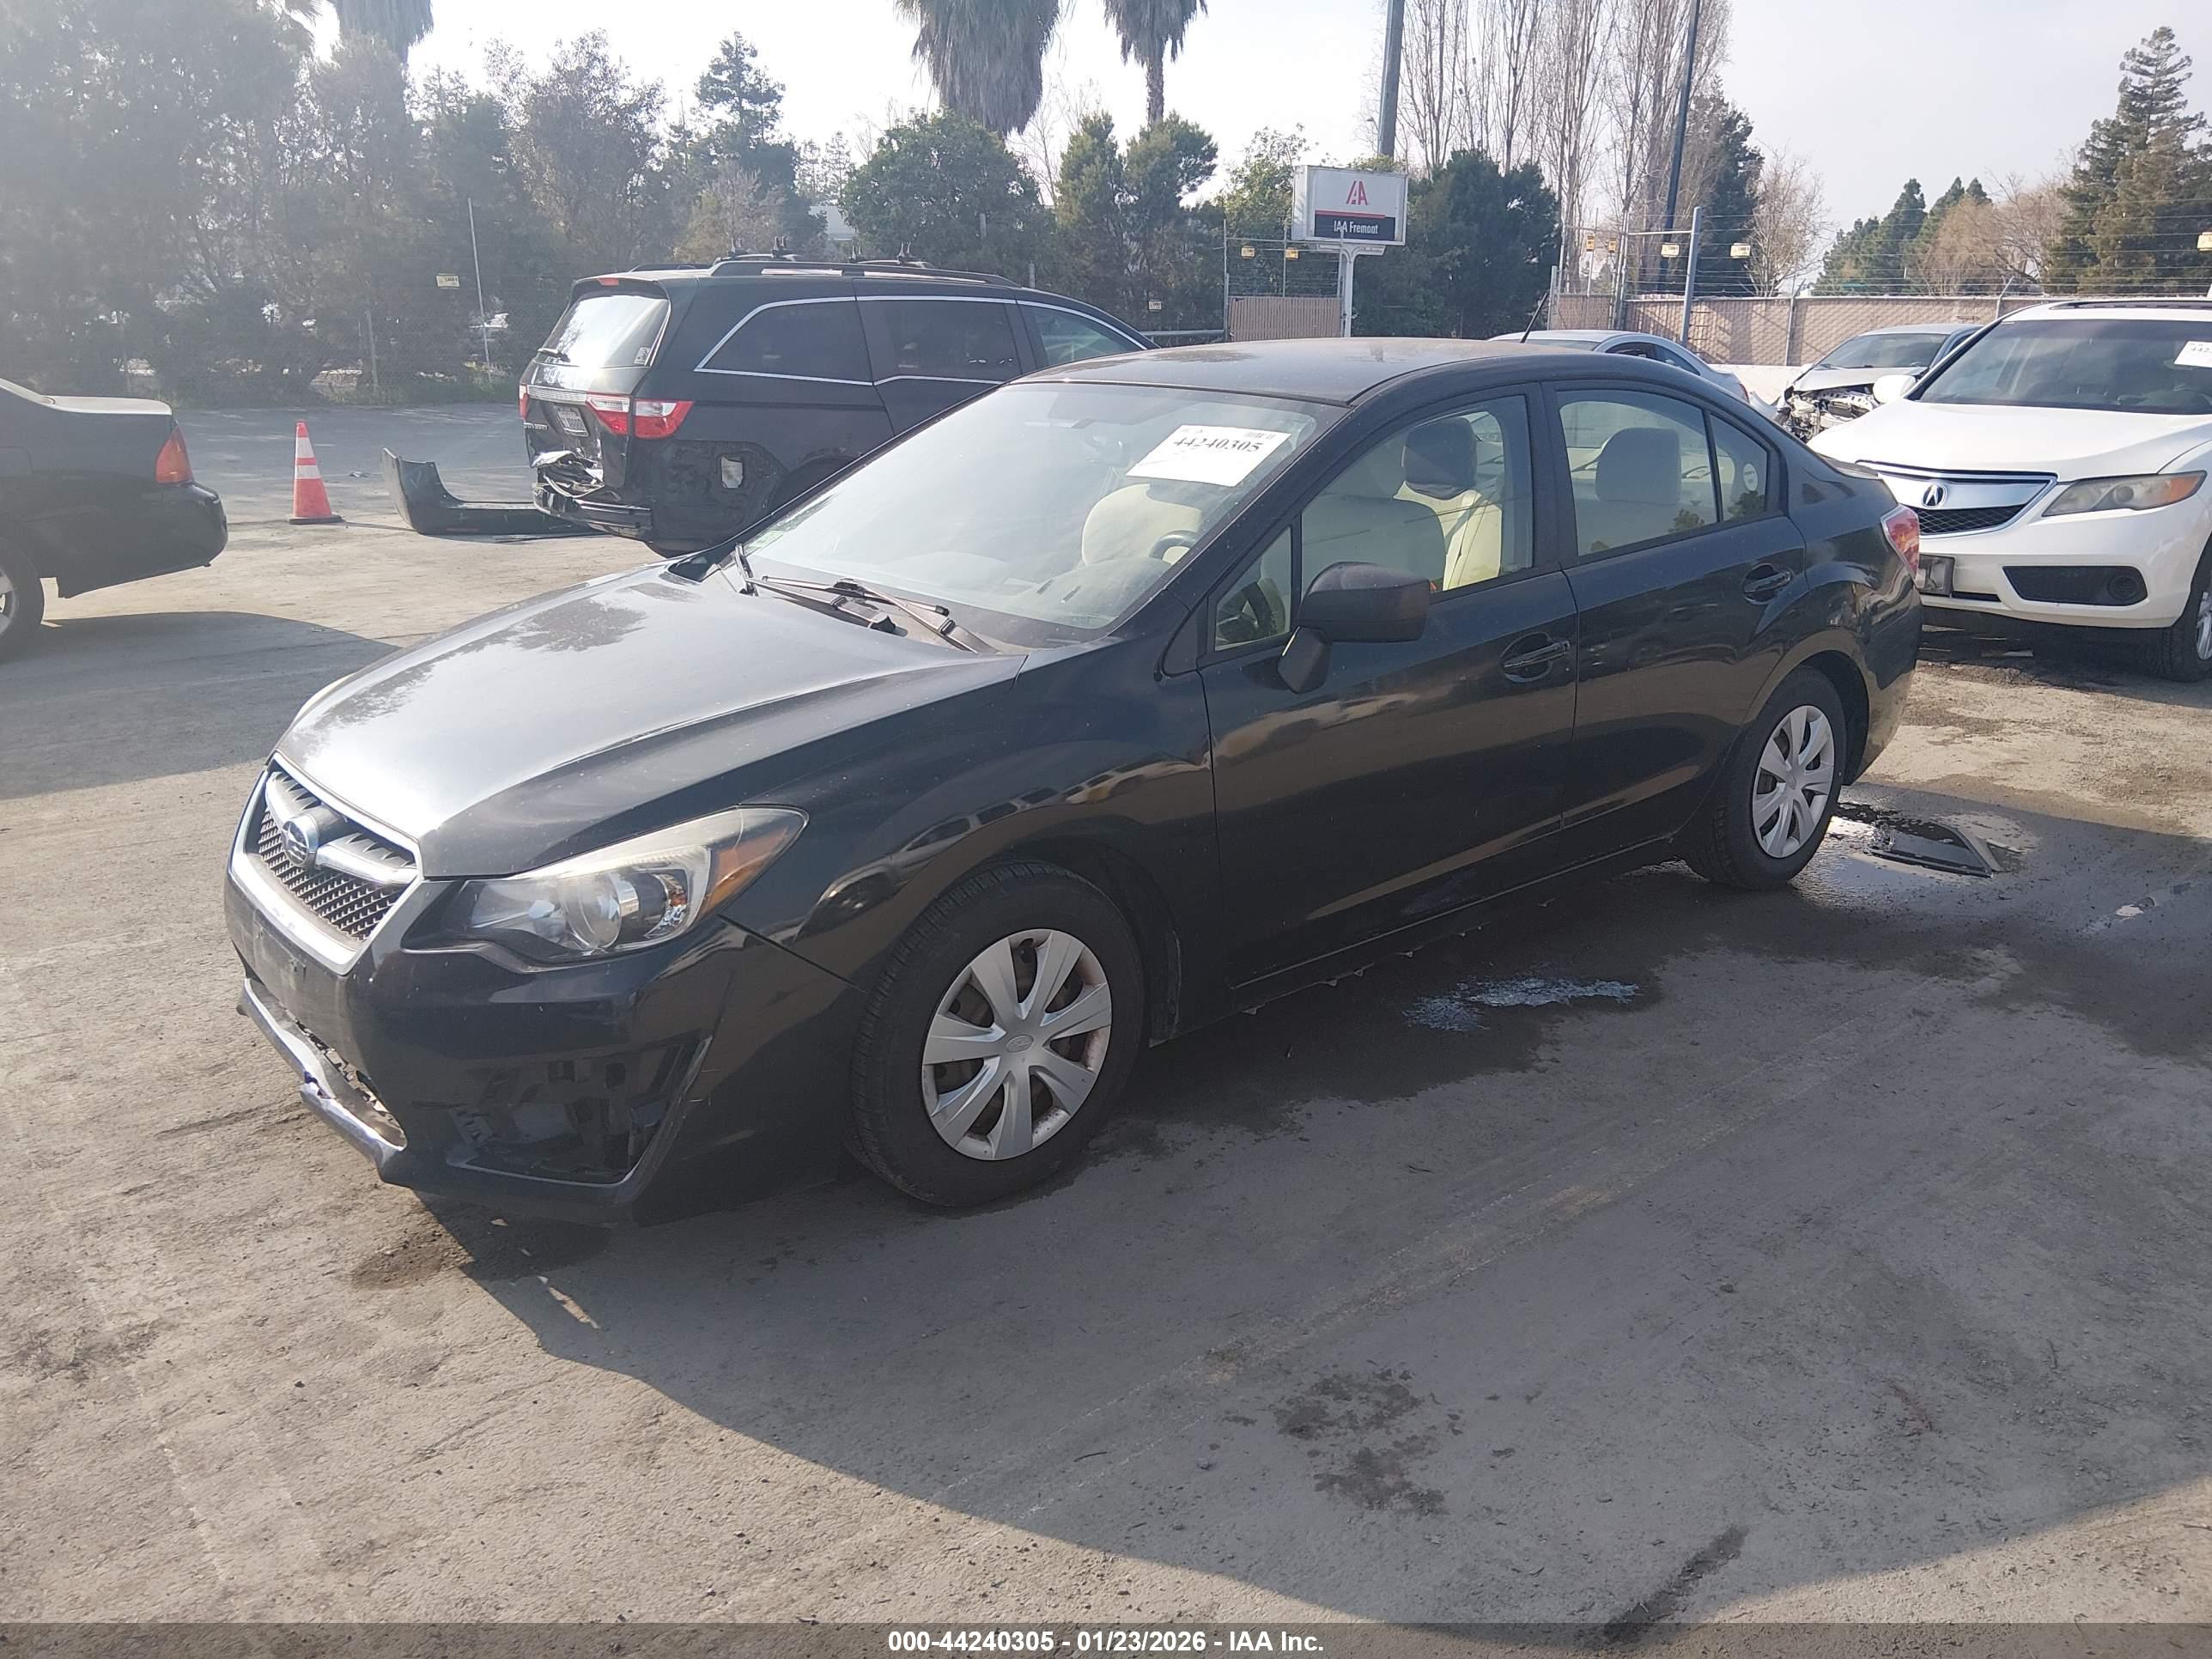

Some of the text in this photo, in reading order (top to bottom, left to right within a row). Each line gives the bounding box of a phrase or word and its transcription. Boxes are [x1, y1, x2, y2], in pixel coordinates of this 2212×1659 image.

[1334, 220, 1379, 234] IAA Fremont
[1173, 437, 1264, 453] 44240305
